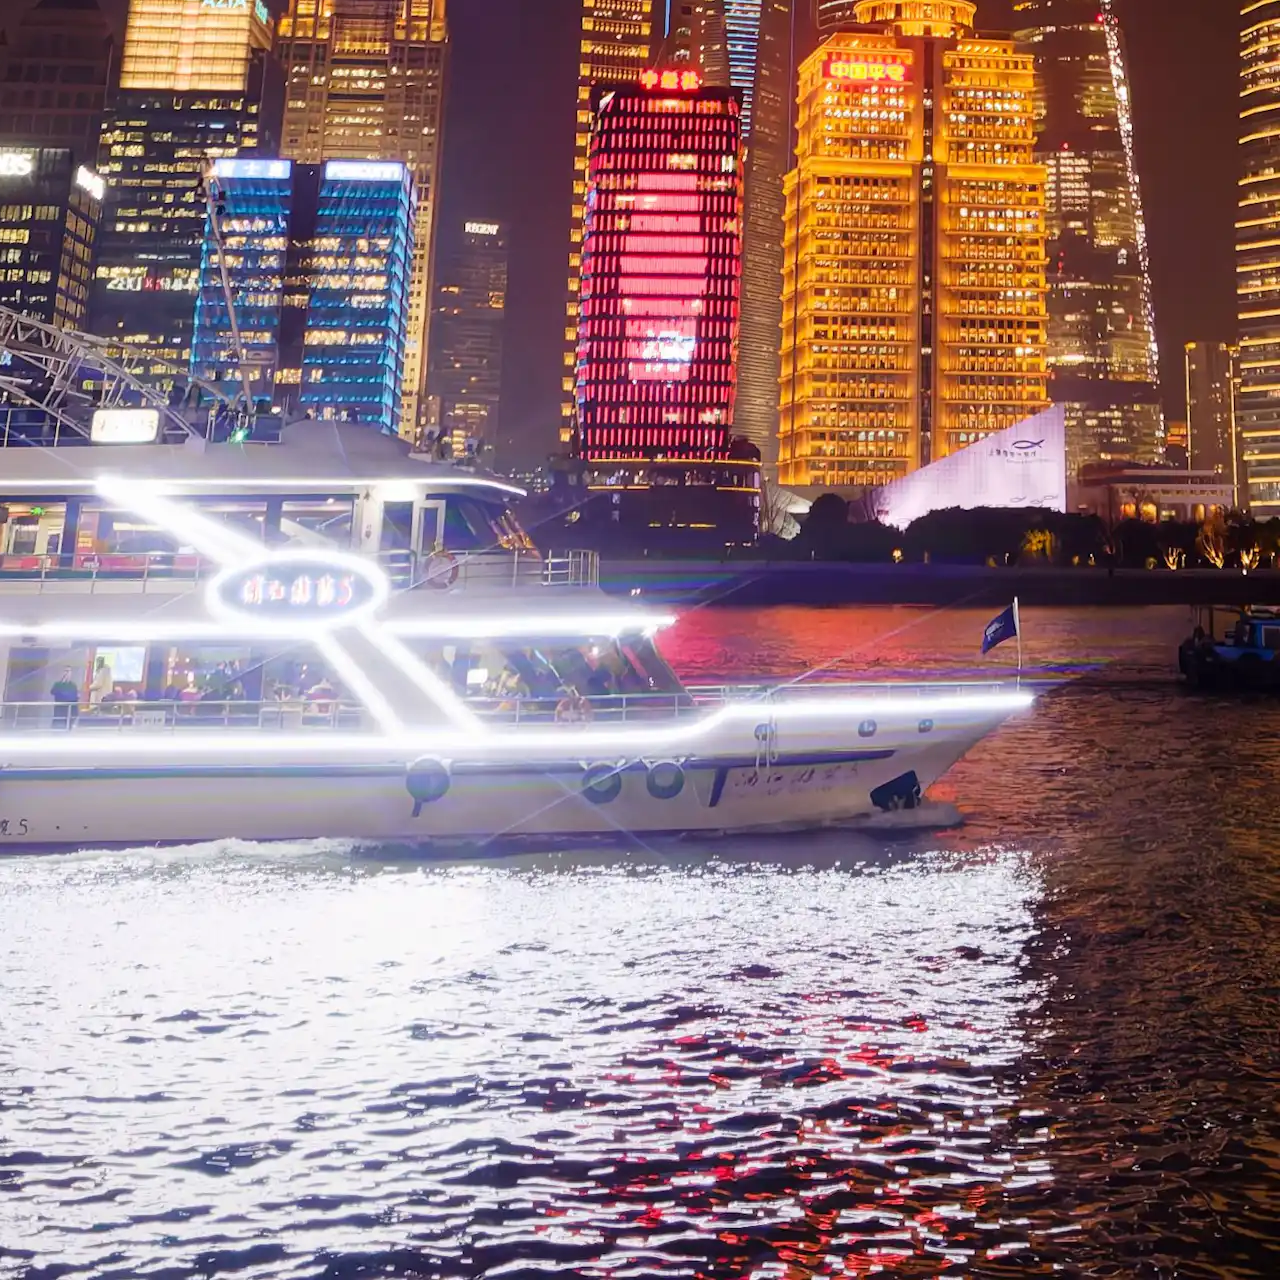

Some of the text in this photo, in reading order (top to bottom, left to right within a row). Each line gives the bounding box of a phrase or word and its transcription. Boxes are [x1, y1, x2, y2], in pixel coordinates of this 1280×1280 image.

[830, 61, 904, 81] 中国平安
[464, 222, 499, 235] REGENT
